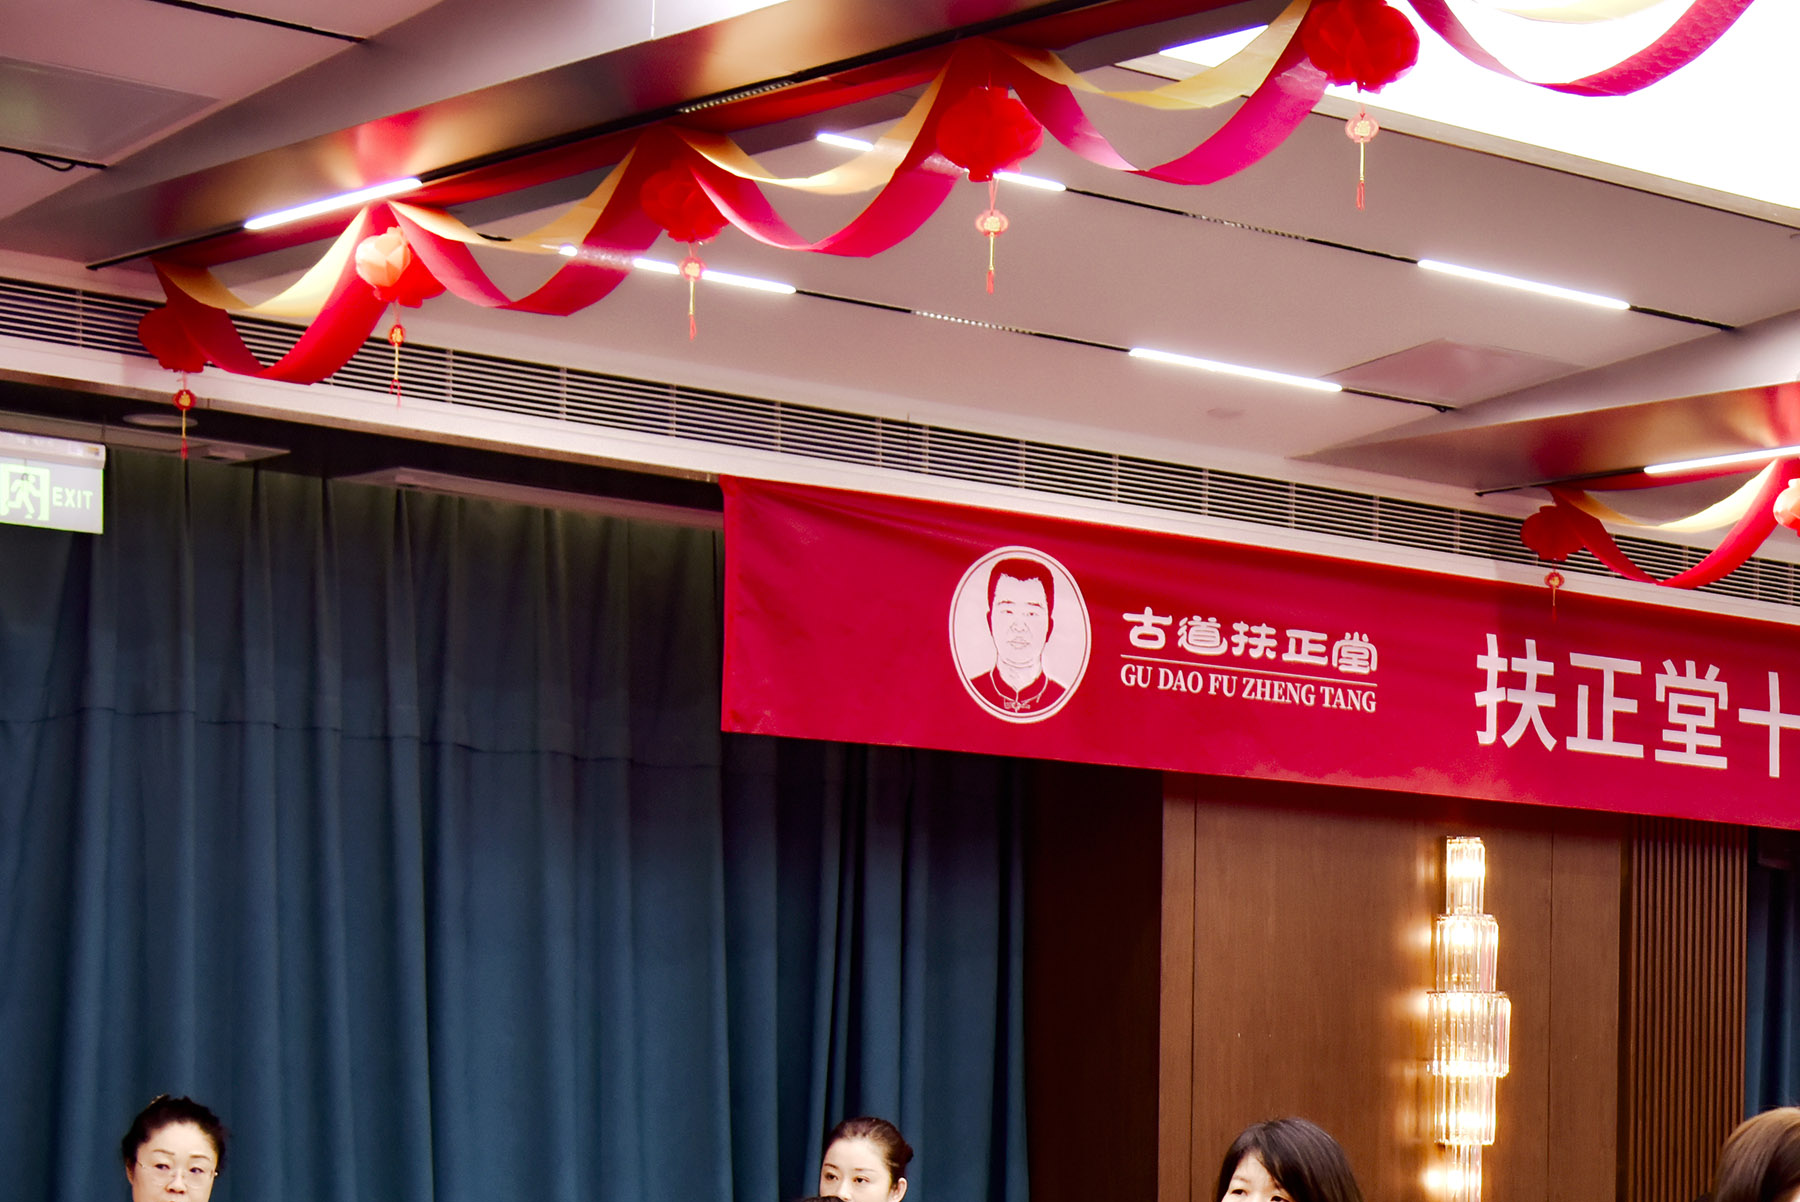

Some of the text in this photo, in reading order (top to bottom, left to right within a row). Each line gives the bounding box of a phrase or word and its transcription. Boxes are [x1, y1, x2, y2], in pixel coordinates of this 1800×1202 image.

[52, 486, 94, 510] EXIT
[1122, 606, 1378, 675] 古道扶正堂
[1120, 663, 1377, 713] GU DAO FU ZHENG TANG
